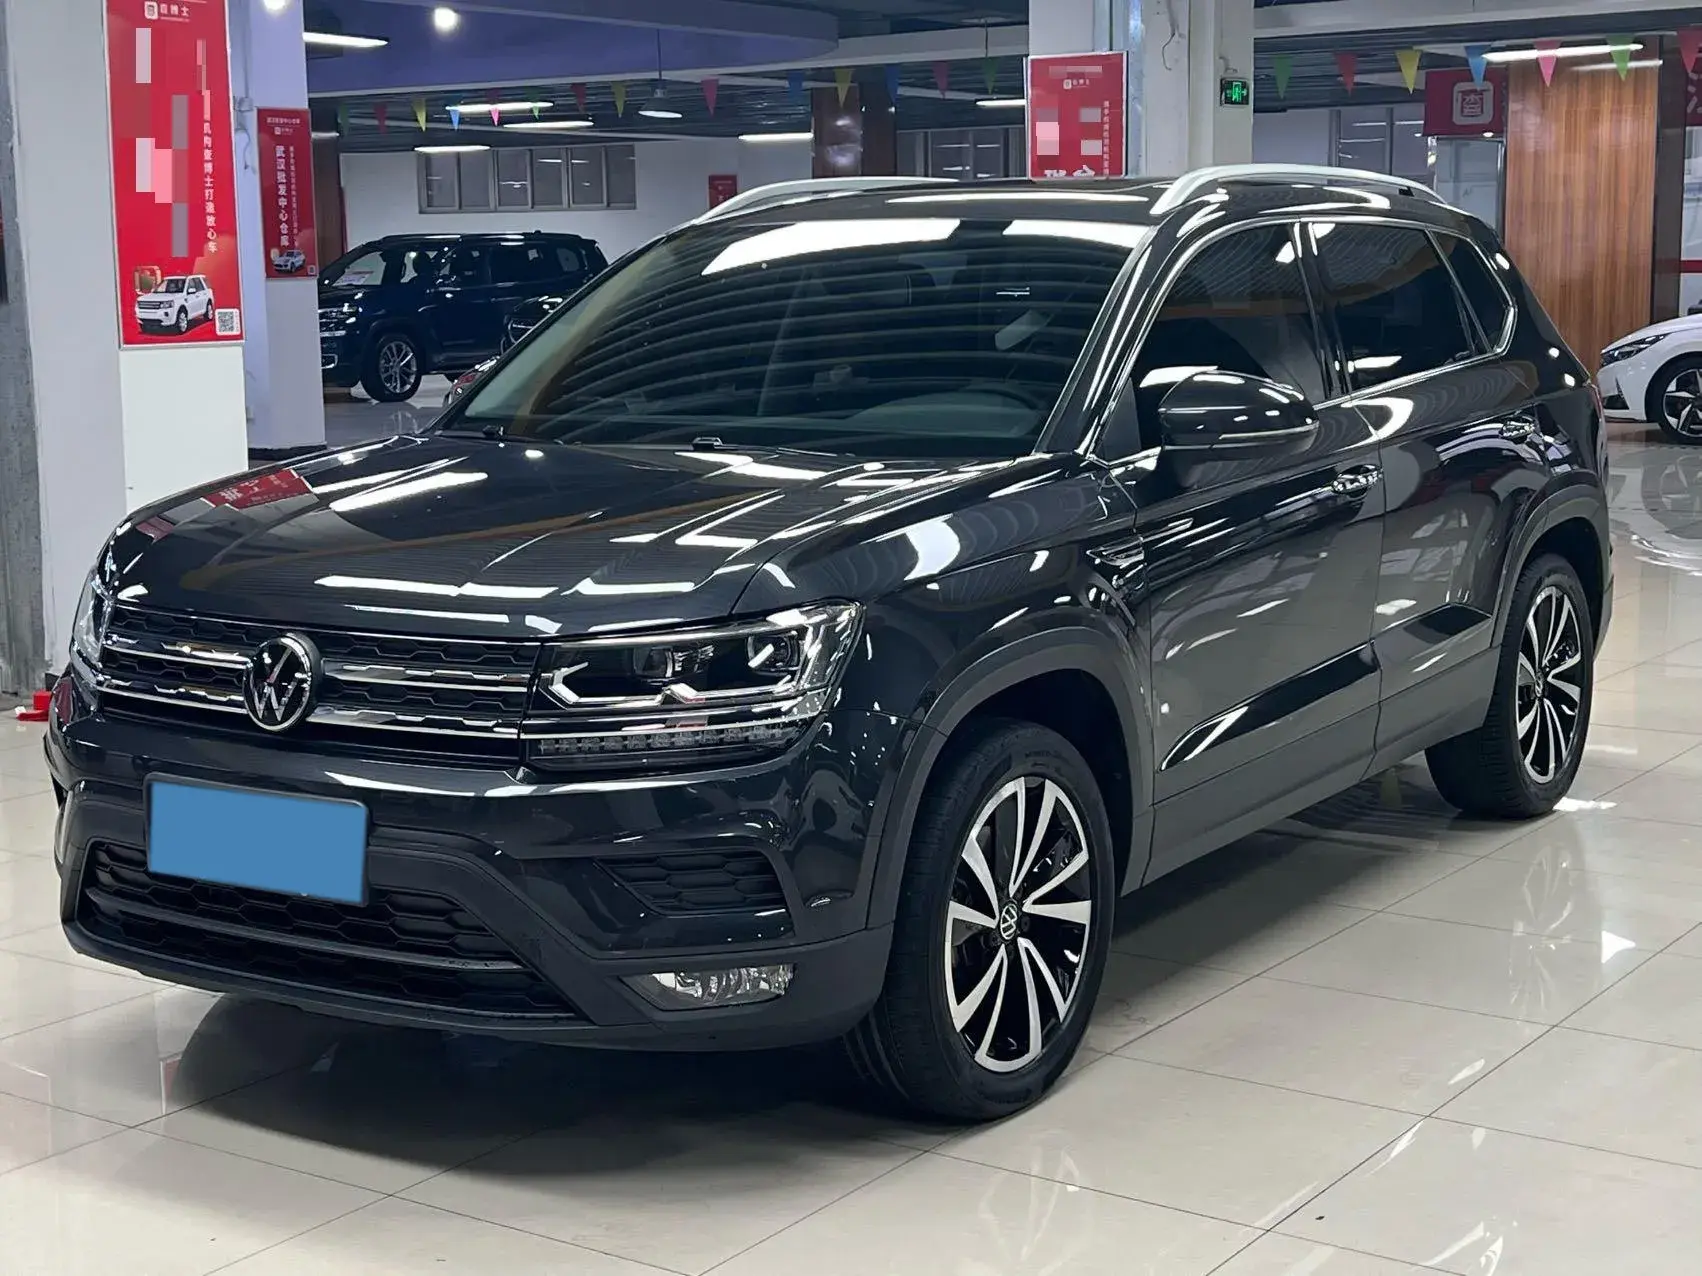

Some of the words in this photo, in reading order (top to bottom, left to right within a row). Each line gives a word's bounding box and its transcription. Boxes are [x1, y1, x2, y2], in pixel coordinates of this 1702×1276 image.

[275, 145, 289, 247] 武汉批发中心仓库
